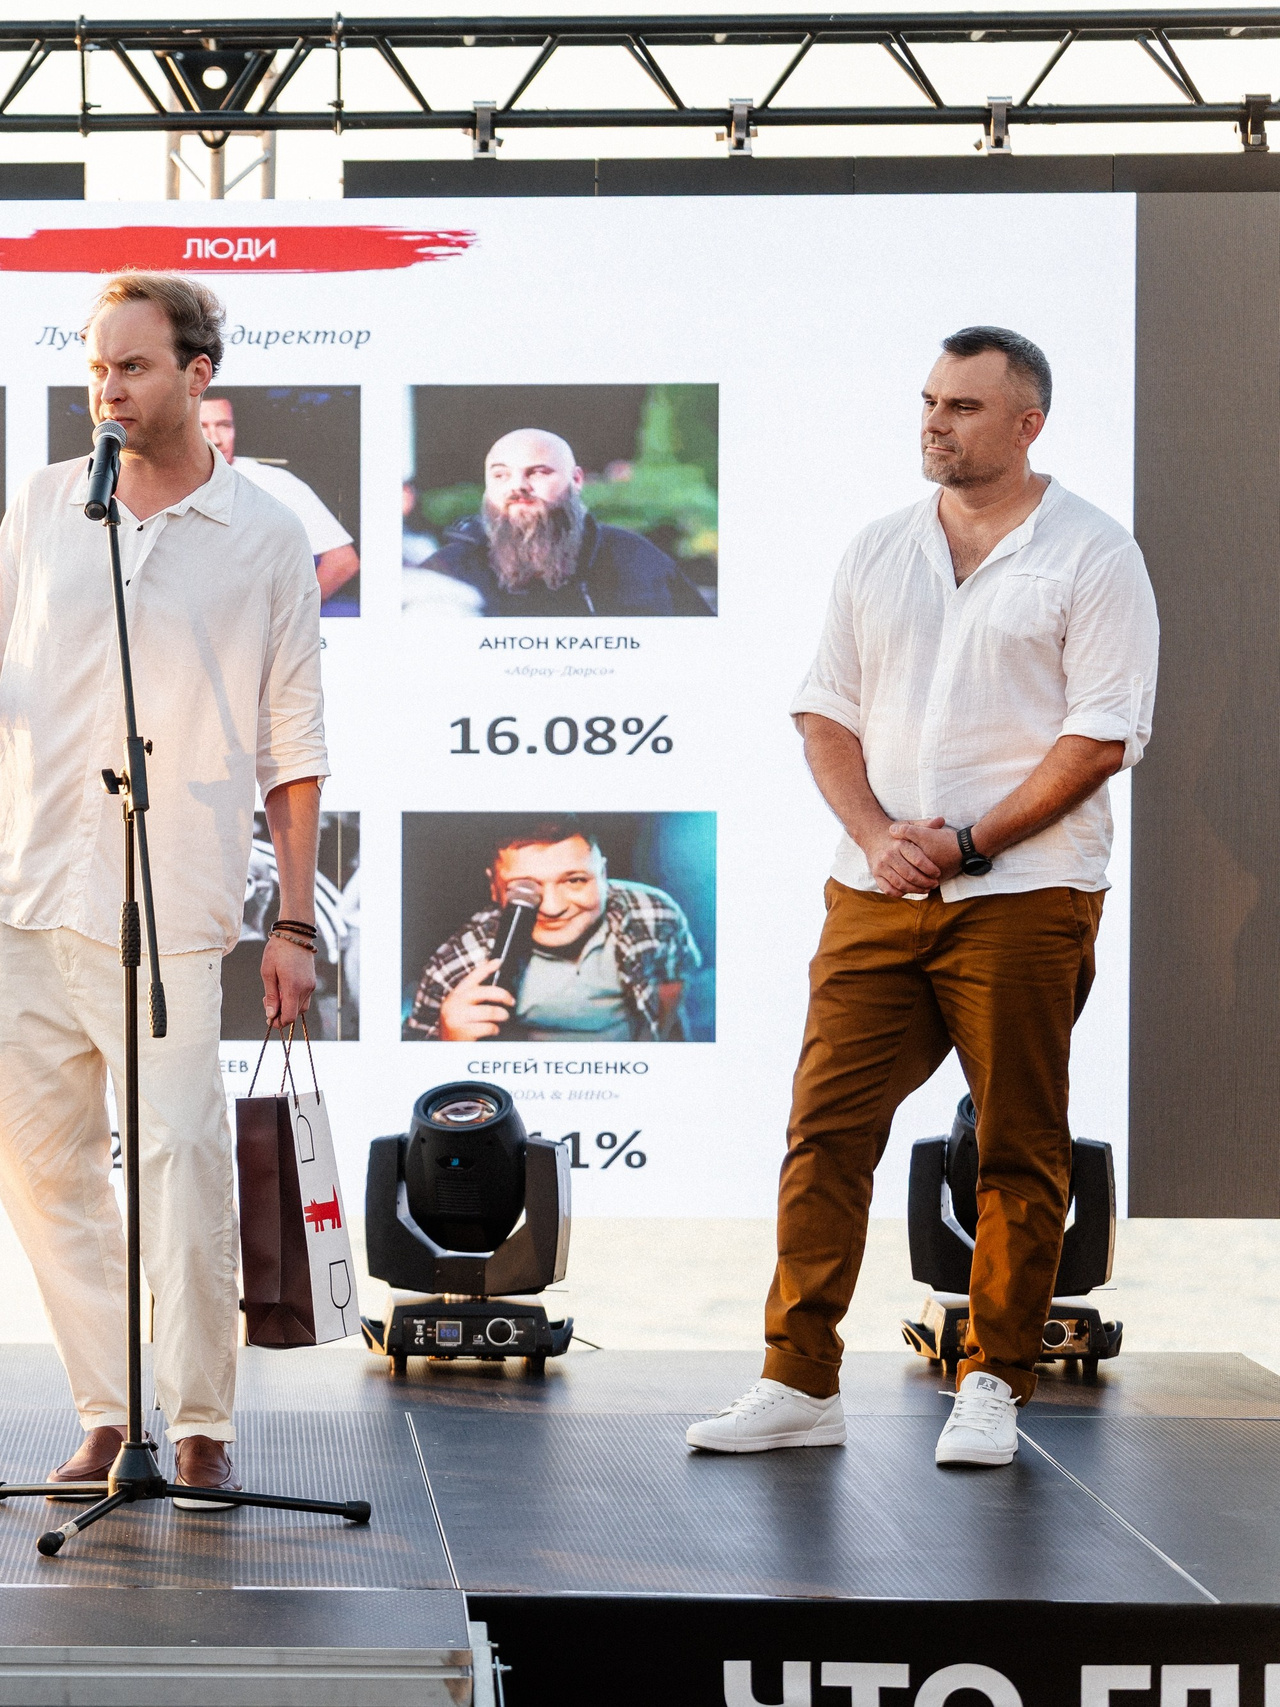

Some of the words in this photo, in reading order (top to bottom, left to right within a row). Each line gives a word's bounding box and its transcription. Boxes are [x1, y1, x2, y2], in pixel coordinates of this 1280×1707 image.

[182, 237, 277, 262] ЛЮДИ
[35, 326, 85, 351] Луч
[479, 636, 549, 650] АНТОН
[556, 636, 641, 650] КРАГЕЛЬ
[450, 715, 674, 756] 16.08%
[467, 1058, 538, 1074] СЕРГЕЙ
[544, 1061, 649, 1075] ТЕСЛЕНКО
